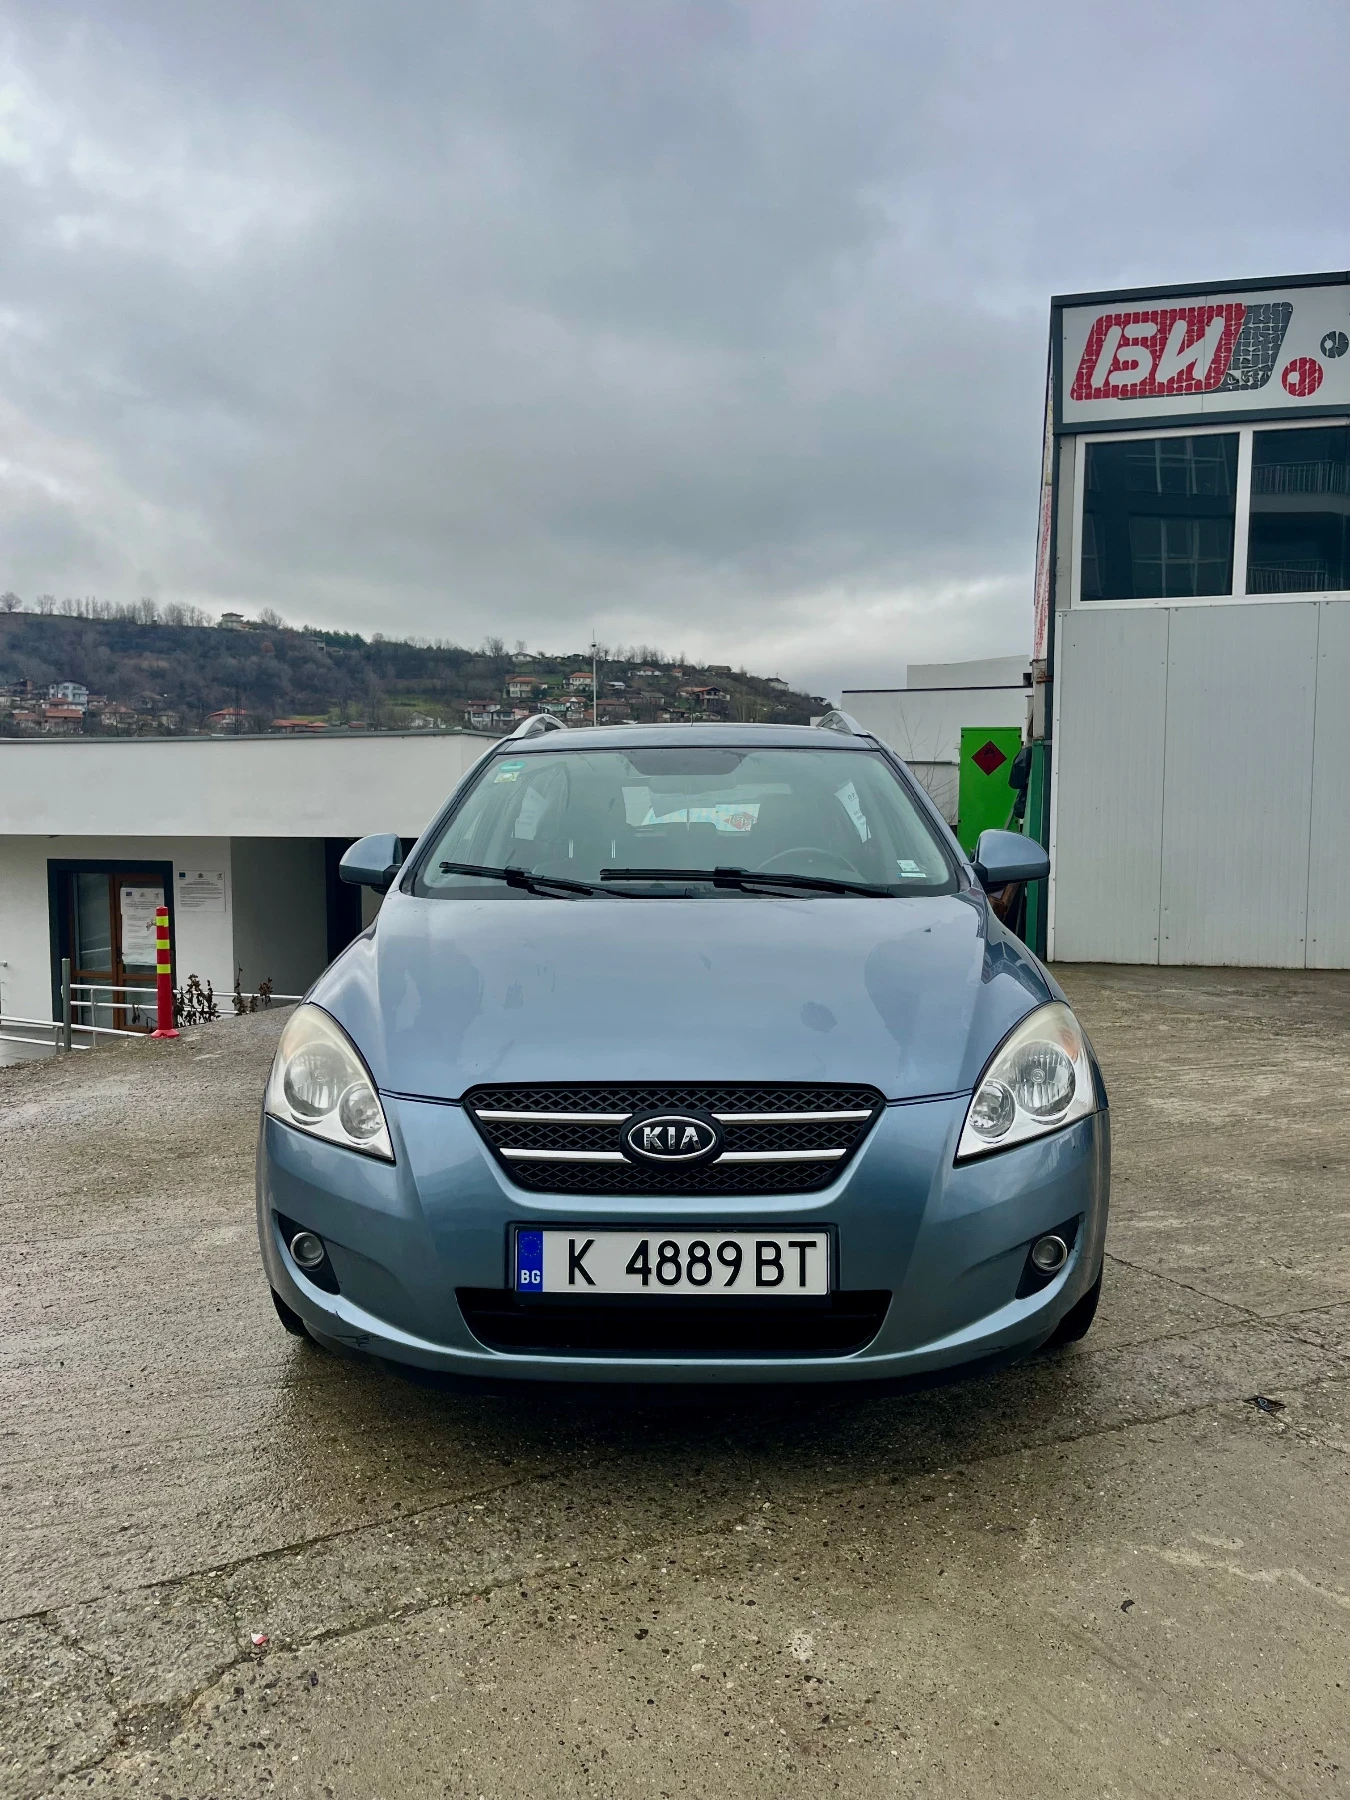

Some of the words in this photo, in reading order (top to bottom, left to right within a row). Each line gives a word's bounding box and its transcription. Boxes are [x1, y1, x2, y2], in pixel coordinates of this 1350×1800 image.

[642, 1126, 702, 1150] KIA
[567, 1238, 597, 1286] K
[520, 1270, 542, 1284] BG
